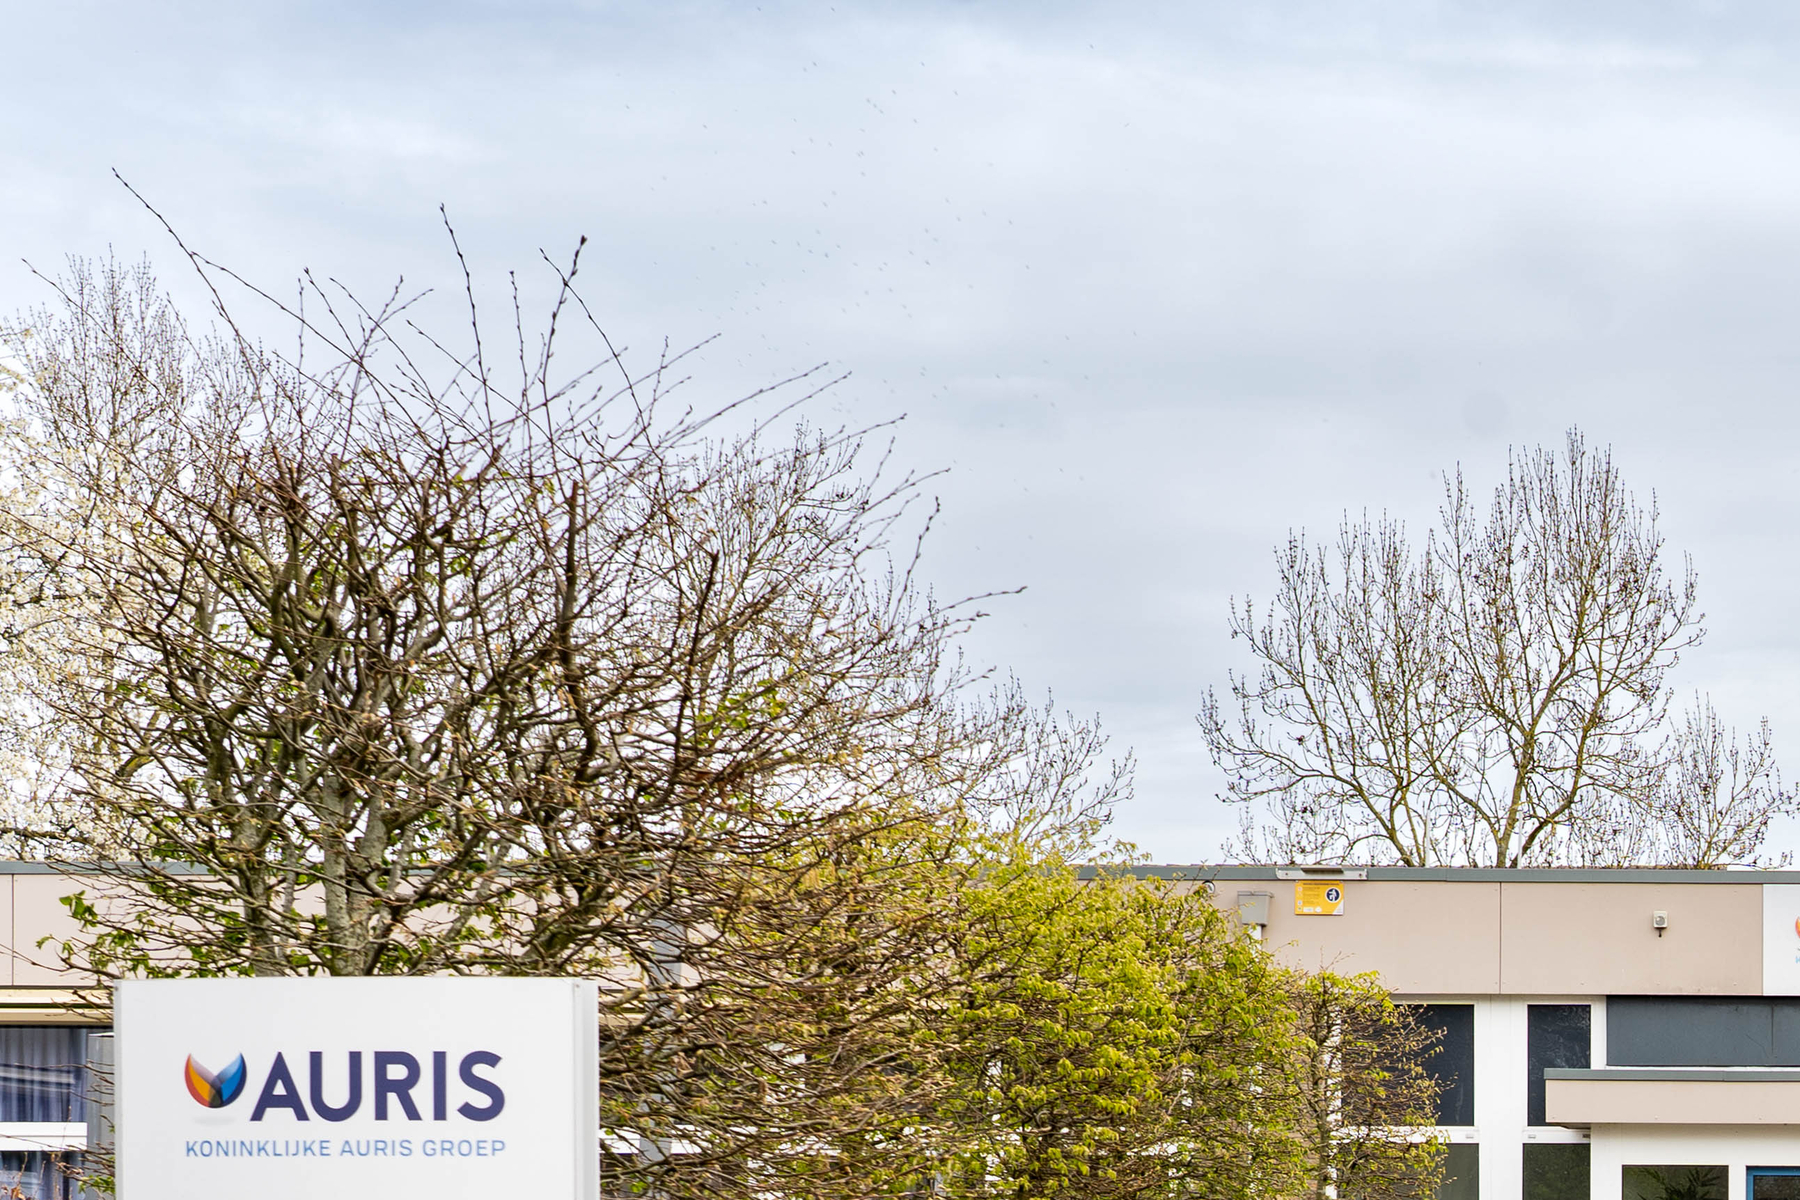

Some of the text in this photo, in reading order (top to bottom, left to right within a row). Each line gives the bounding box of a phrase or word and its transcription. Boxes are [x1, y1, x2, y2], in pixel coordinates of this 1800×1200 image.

[248, 1050, 505, 1122] AURIS
[186, 1139, 505, 1158] KONINKLIJKE AURIS GROEP
